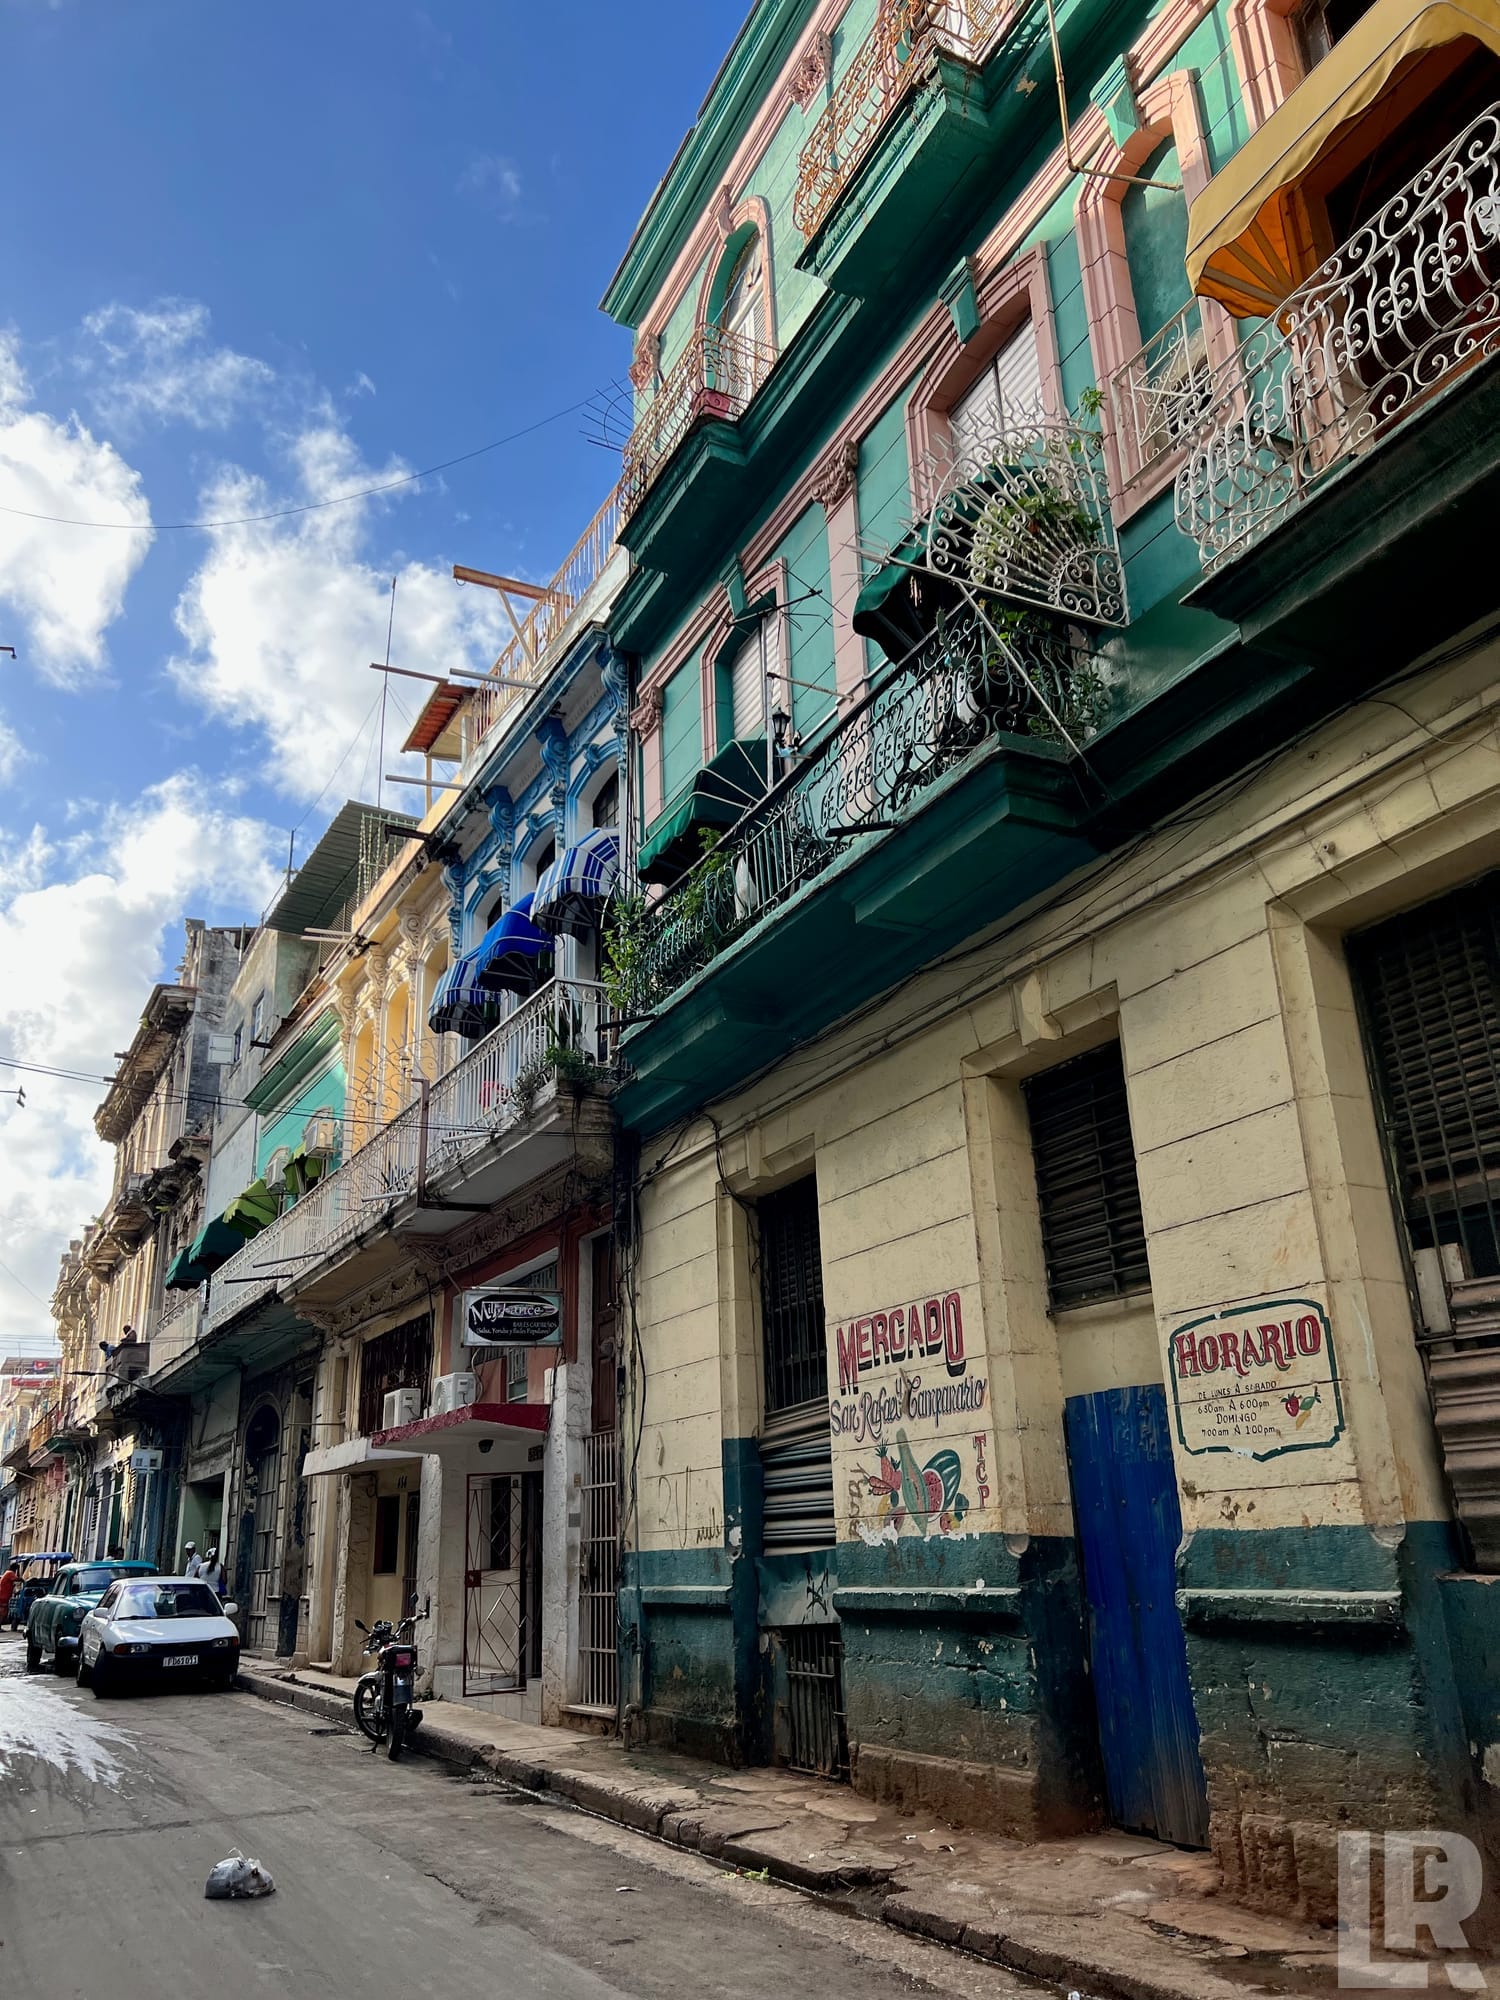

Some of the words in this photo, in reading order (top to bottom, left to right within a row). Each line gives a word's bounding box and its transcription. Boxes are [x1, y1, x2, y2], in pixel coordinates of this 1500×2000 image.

[837, 1291, 966, 1396] MERCADO
[1174, 1314, 1322, 1379] HORARIO
[1198, 1391, 1207, 1400] DE
[1211, 1387, 1231, 1398] LUNES
[1235, 1383, 1241, 1394] A
[831, 1400, 860, 1436] San
[855, 1387, 902, 1443] Rafael
[906, 1375, 987, 1428] Campanario
[1229, 1399, 1237, 1411] A
[1216, 1412, 1257, 1425] DOMINGO
[1234, 1424, 1241, 1435] A
